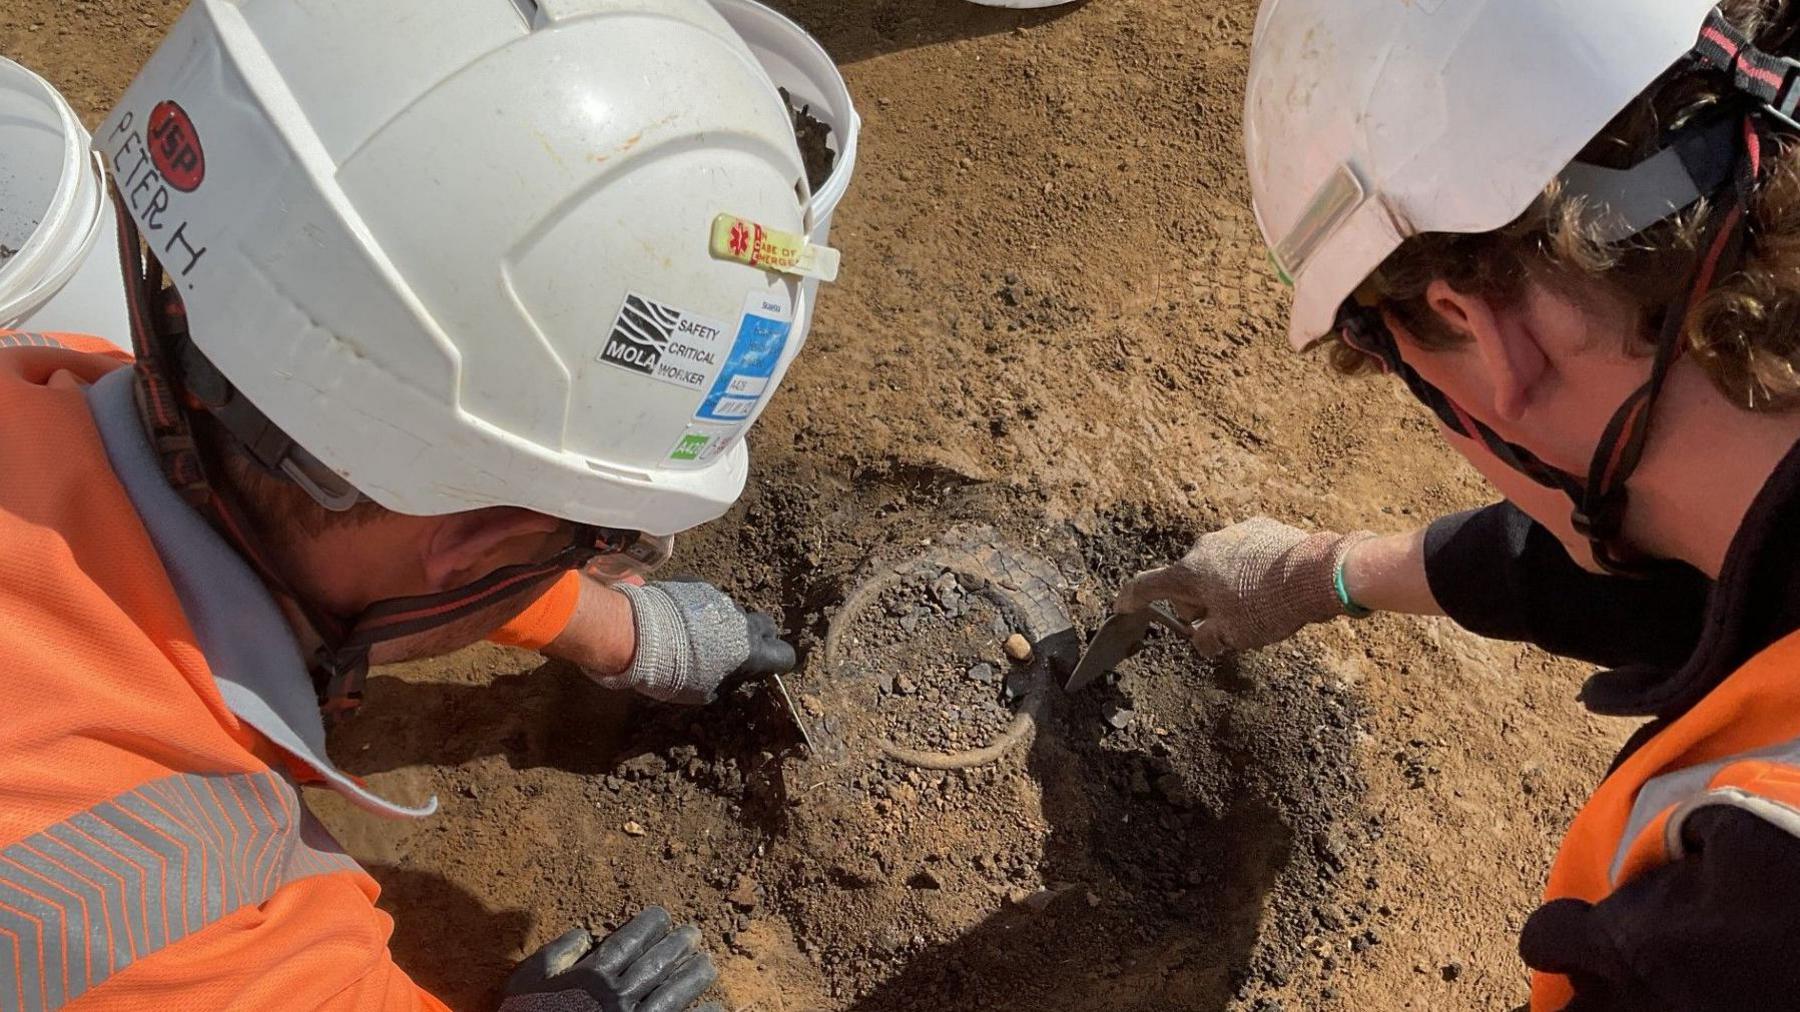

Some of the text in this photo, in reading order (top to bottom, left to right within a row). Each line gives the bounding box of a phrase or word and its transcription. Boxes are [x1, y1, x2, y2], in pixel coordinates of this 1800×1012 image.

[151, 117, 199, 172] JSP
[108, 111, 206, 290] PETER H.
[678, 319, 720, 341] SAFETY
[606, 340, 657, 370] MOLA
[668, 341, 715, 365] CRITICAL
[658, 362, 705, 386] WORKER
